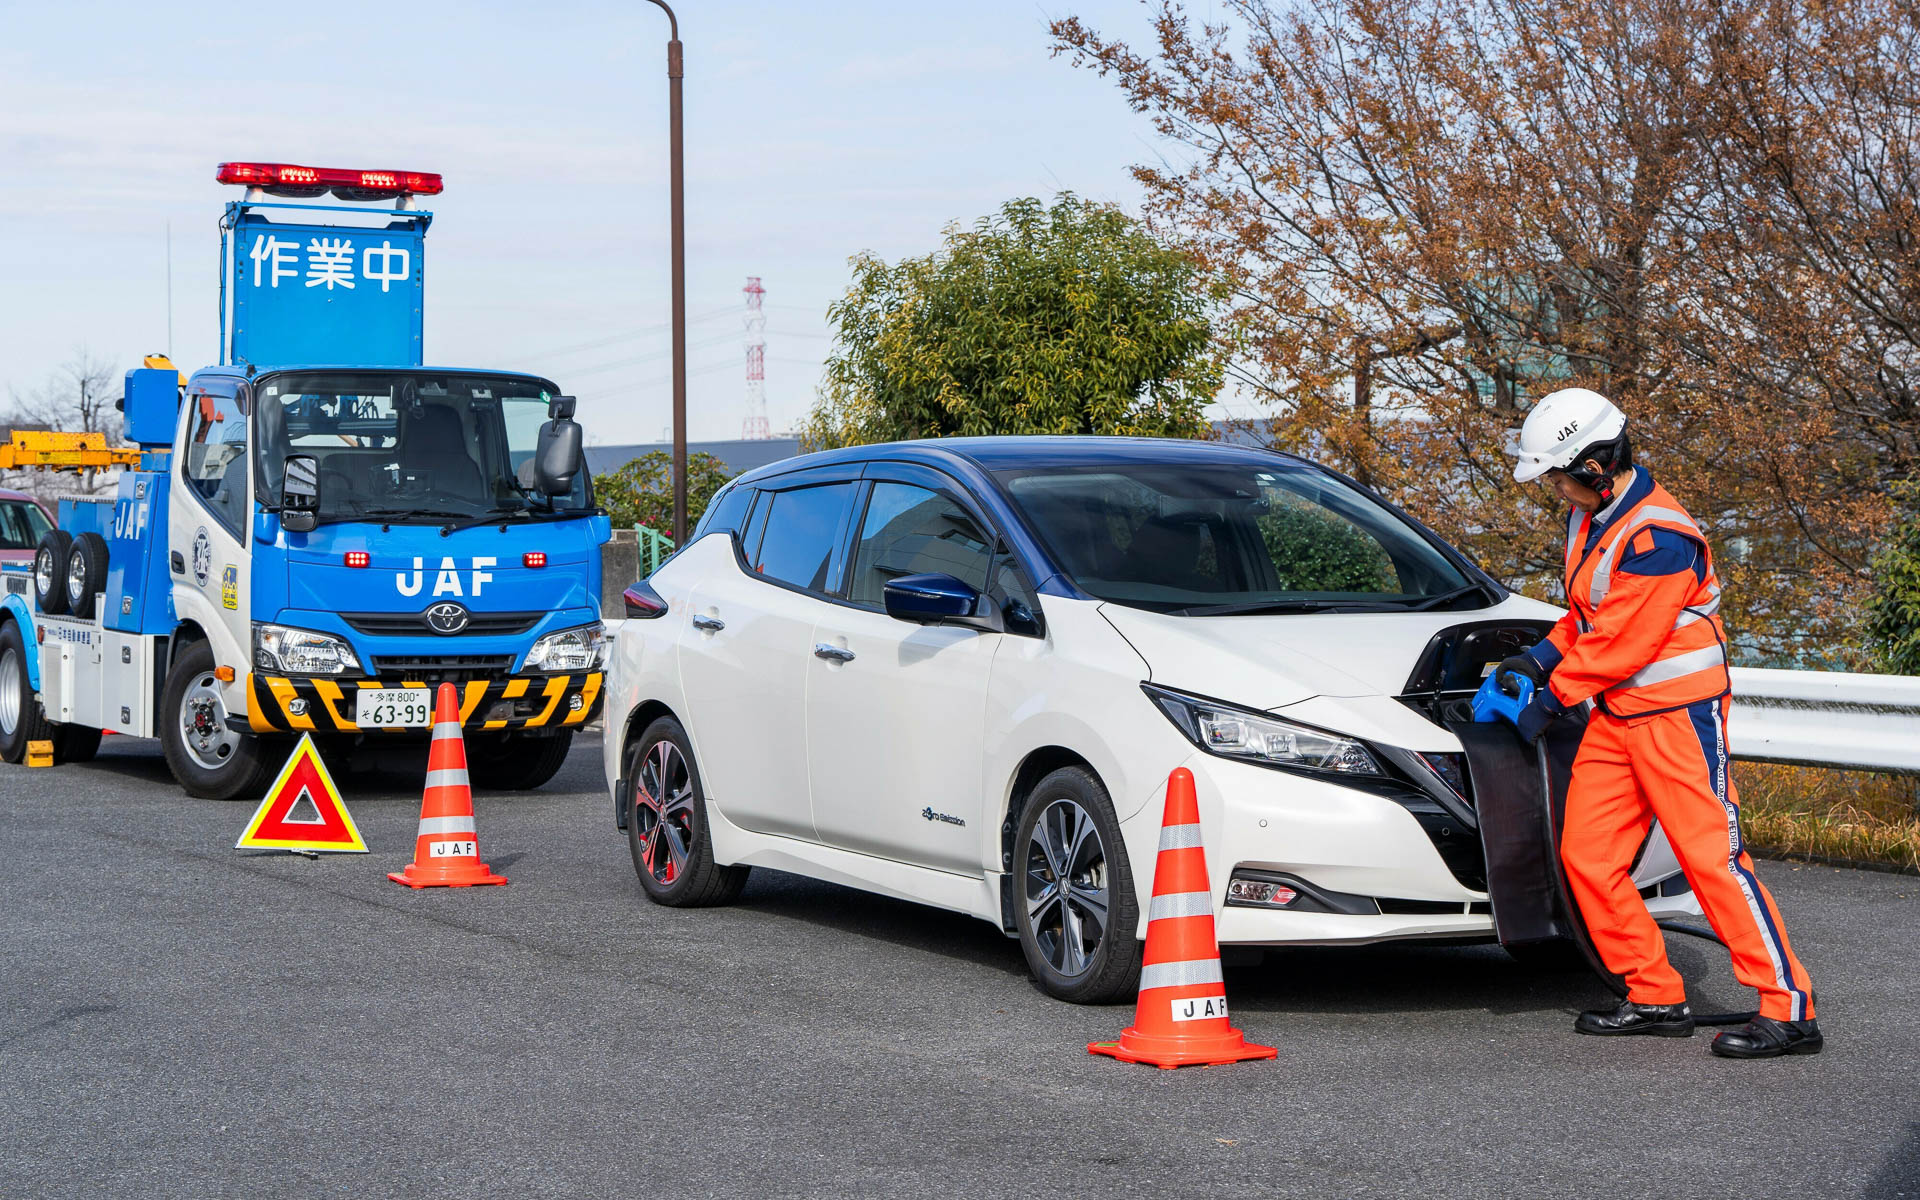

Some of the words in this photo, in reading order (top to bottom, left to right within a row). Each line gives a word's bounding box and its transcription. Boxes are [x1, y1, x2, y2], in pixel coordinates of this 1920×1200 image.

[250, 234, 410, 293] 作業中
[1557, 420, 1579, 442] JAF
[115, 502, 148, 541] JAF
[396, 556, 497, 597] JAF
[375, 692, 396, 703] 多摩
[397, 692, 416, 703] 800
[373, 704, 427, 724] 63-99
[437, 842, 472, 855] JAF
